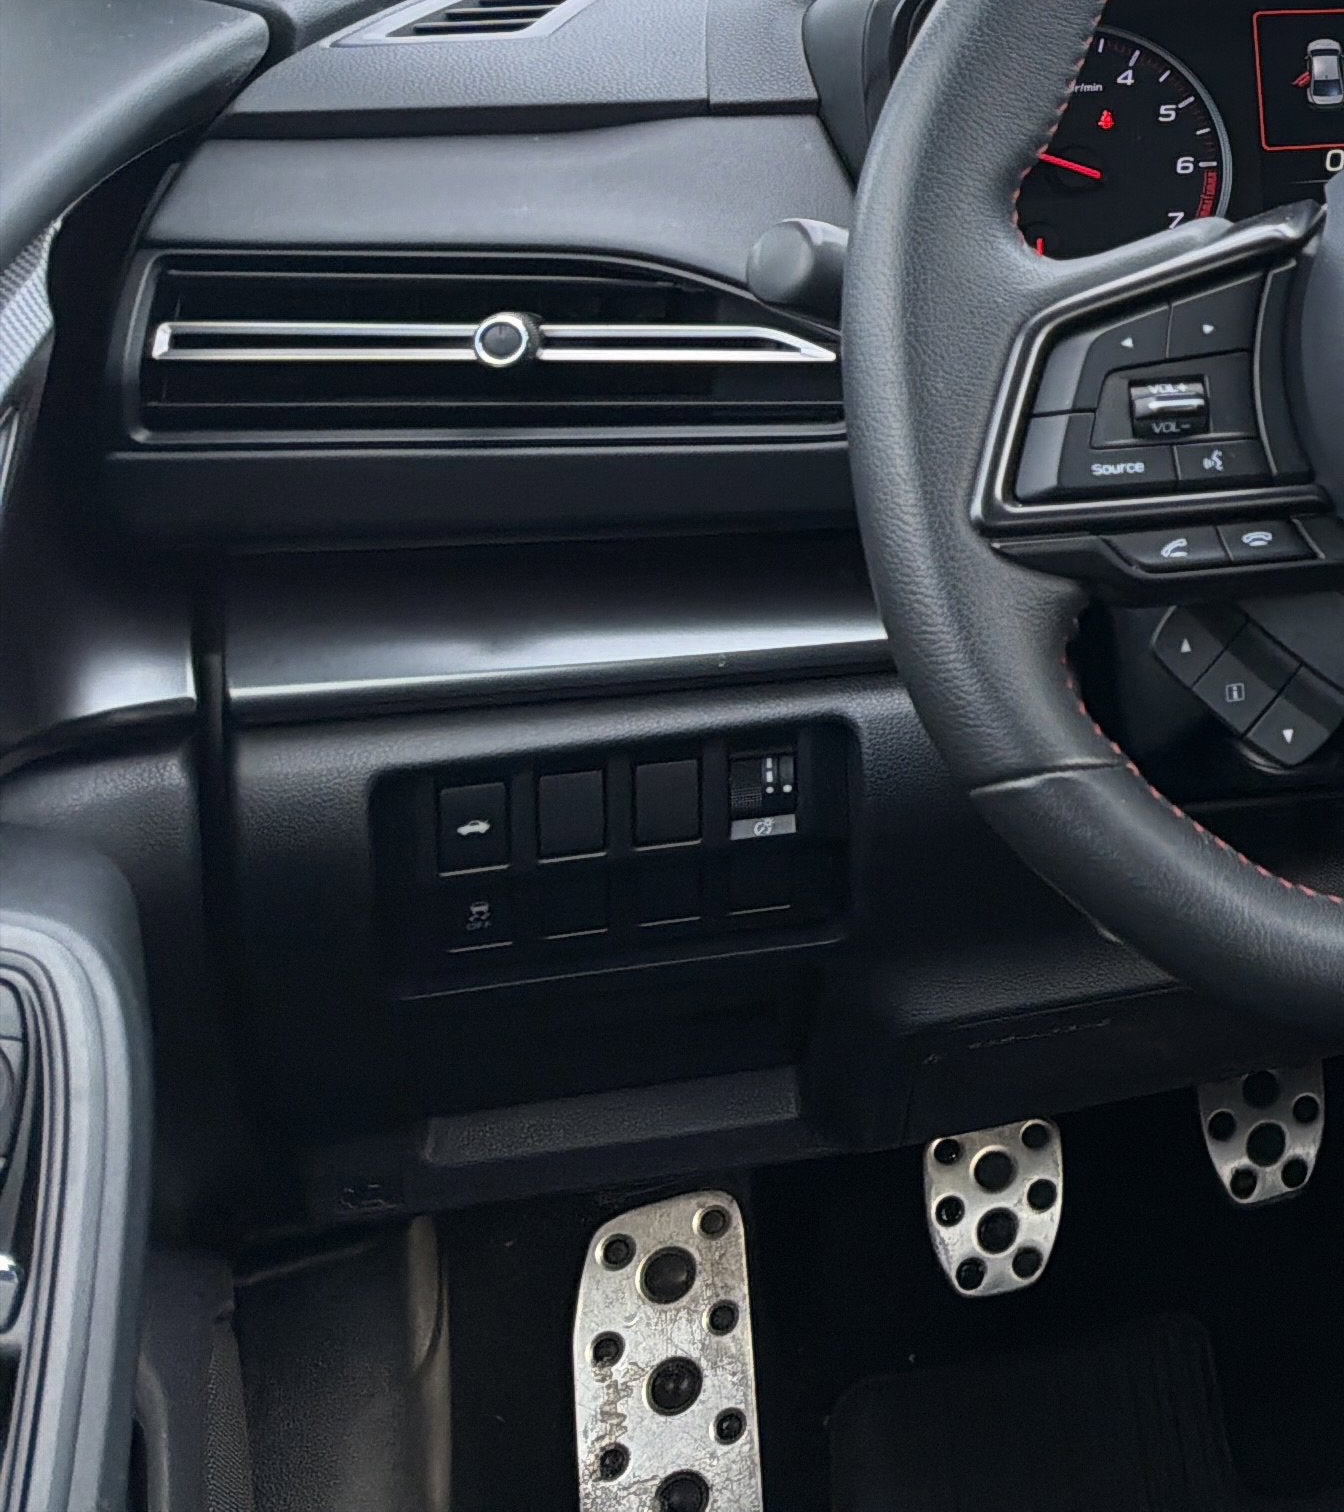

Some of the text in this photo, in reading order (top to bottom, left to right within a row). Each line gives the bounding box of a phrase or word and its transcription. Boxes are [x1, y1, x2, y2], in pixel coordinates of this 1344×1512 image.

[1116, 69, 1135, 86] 4
[1158, 104, 1177, 122] 5
[1176, 156, 1195, 174] 6
[1325, 148, 1344, 172] 0
[1167, 211, 1185, 229] 7
[1091, 460, 1145, 476] Source
